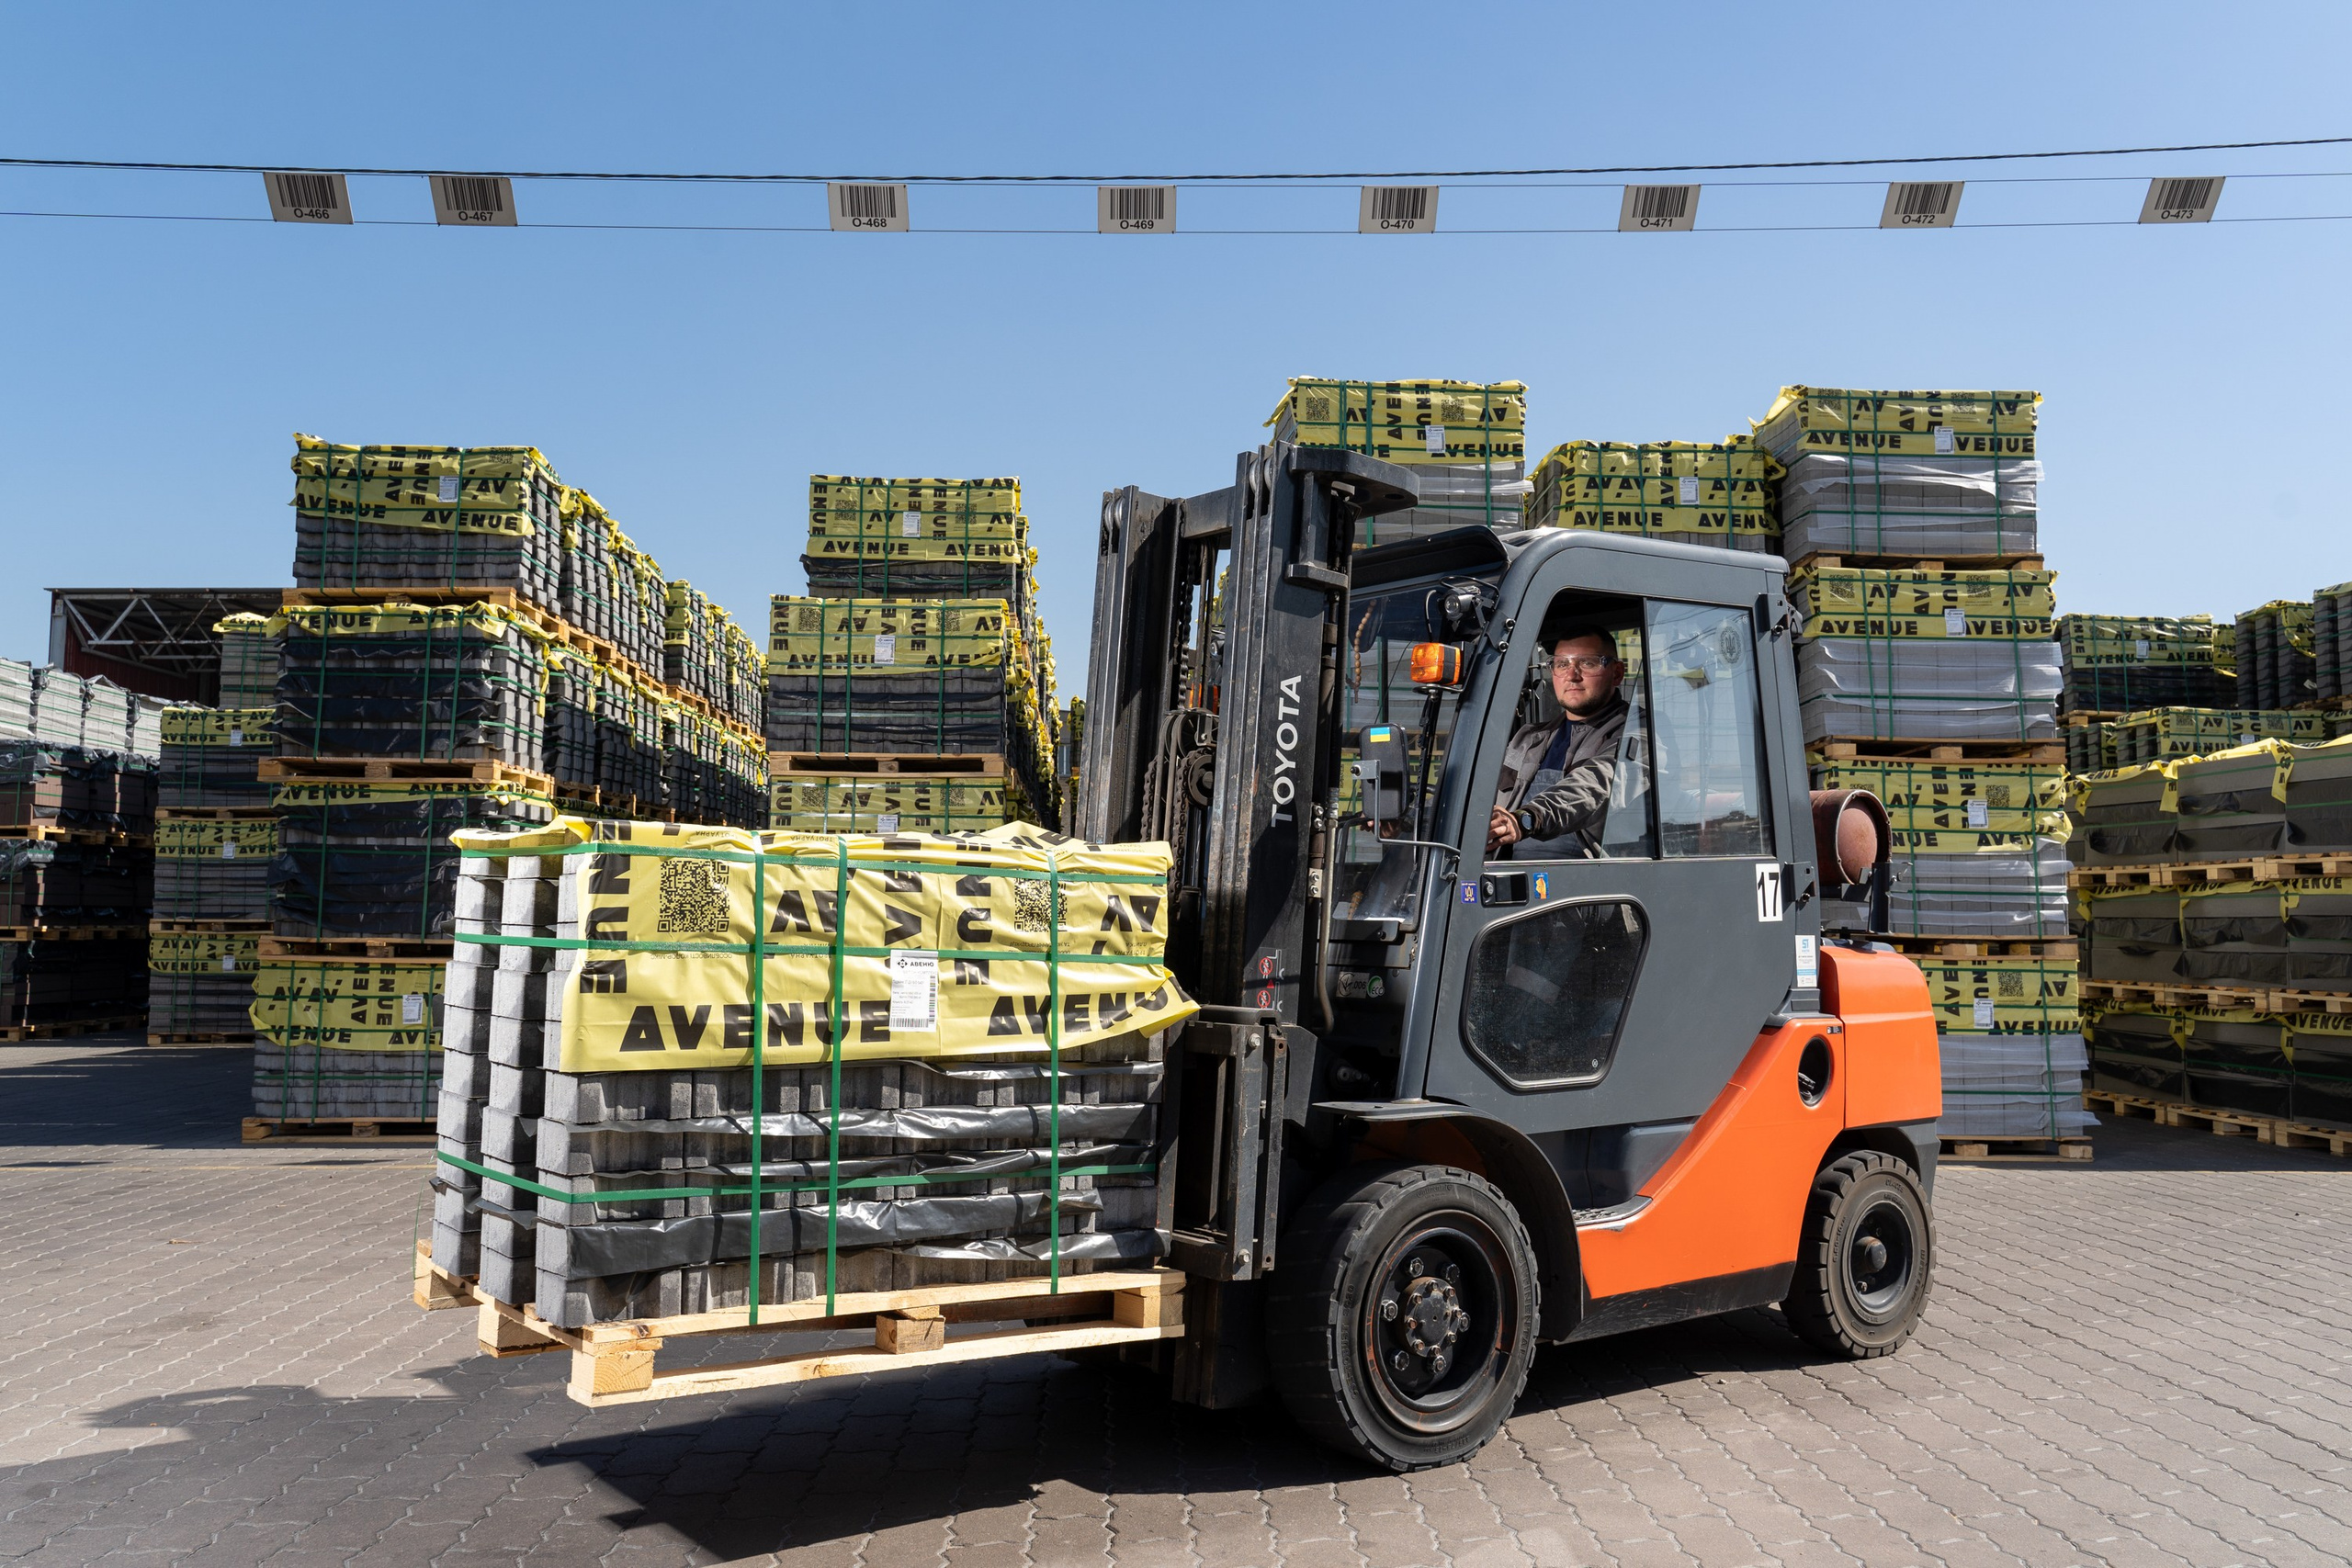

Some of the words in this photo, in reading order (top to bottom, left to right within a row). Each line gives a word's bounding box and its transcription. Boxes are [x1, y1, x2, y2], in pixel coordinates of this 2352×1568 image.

[293, 208, 330, 220] O-466
[458, 210, 493, 221] O-467
[1902, 214, 1936, 225] O-472
[2161, 209, 2194, 220] O-473
[852, 218, 888, 228] O-468
[1119, 220, 1154, 231] O-469
[1380, 220, 1415, 230] O-470
[1640, 218, 1673, 228] O-471
[1806, 432, 1901, 449] AVENUE
[1954, 436, 2034, 453] VENUE
[296, 493, 386, 519] AVENUE
[422, 510, 518, 531] AVENUE
[1574, 511, 1663, 527] AVENUE
[822, 540, 910, 556] AVENUE
[290, 610, 371, 629] VENUE
[1820, 619, 1917, 636] AVENUE
[1271, 674, 1302, 828] TOYOTA
[158, 845, 215, 855] AVENUE
[1757, 871, 1780, 918] 17
[271, 1024, 352, 1043] VENUE
[619, 999, 891, 1052] AVENUE
[389, 1031, 446, 1045] AVE
